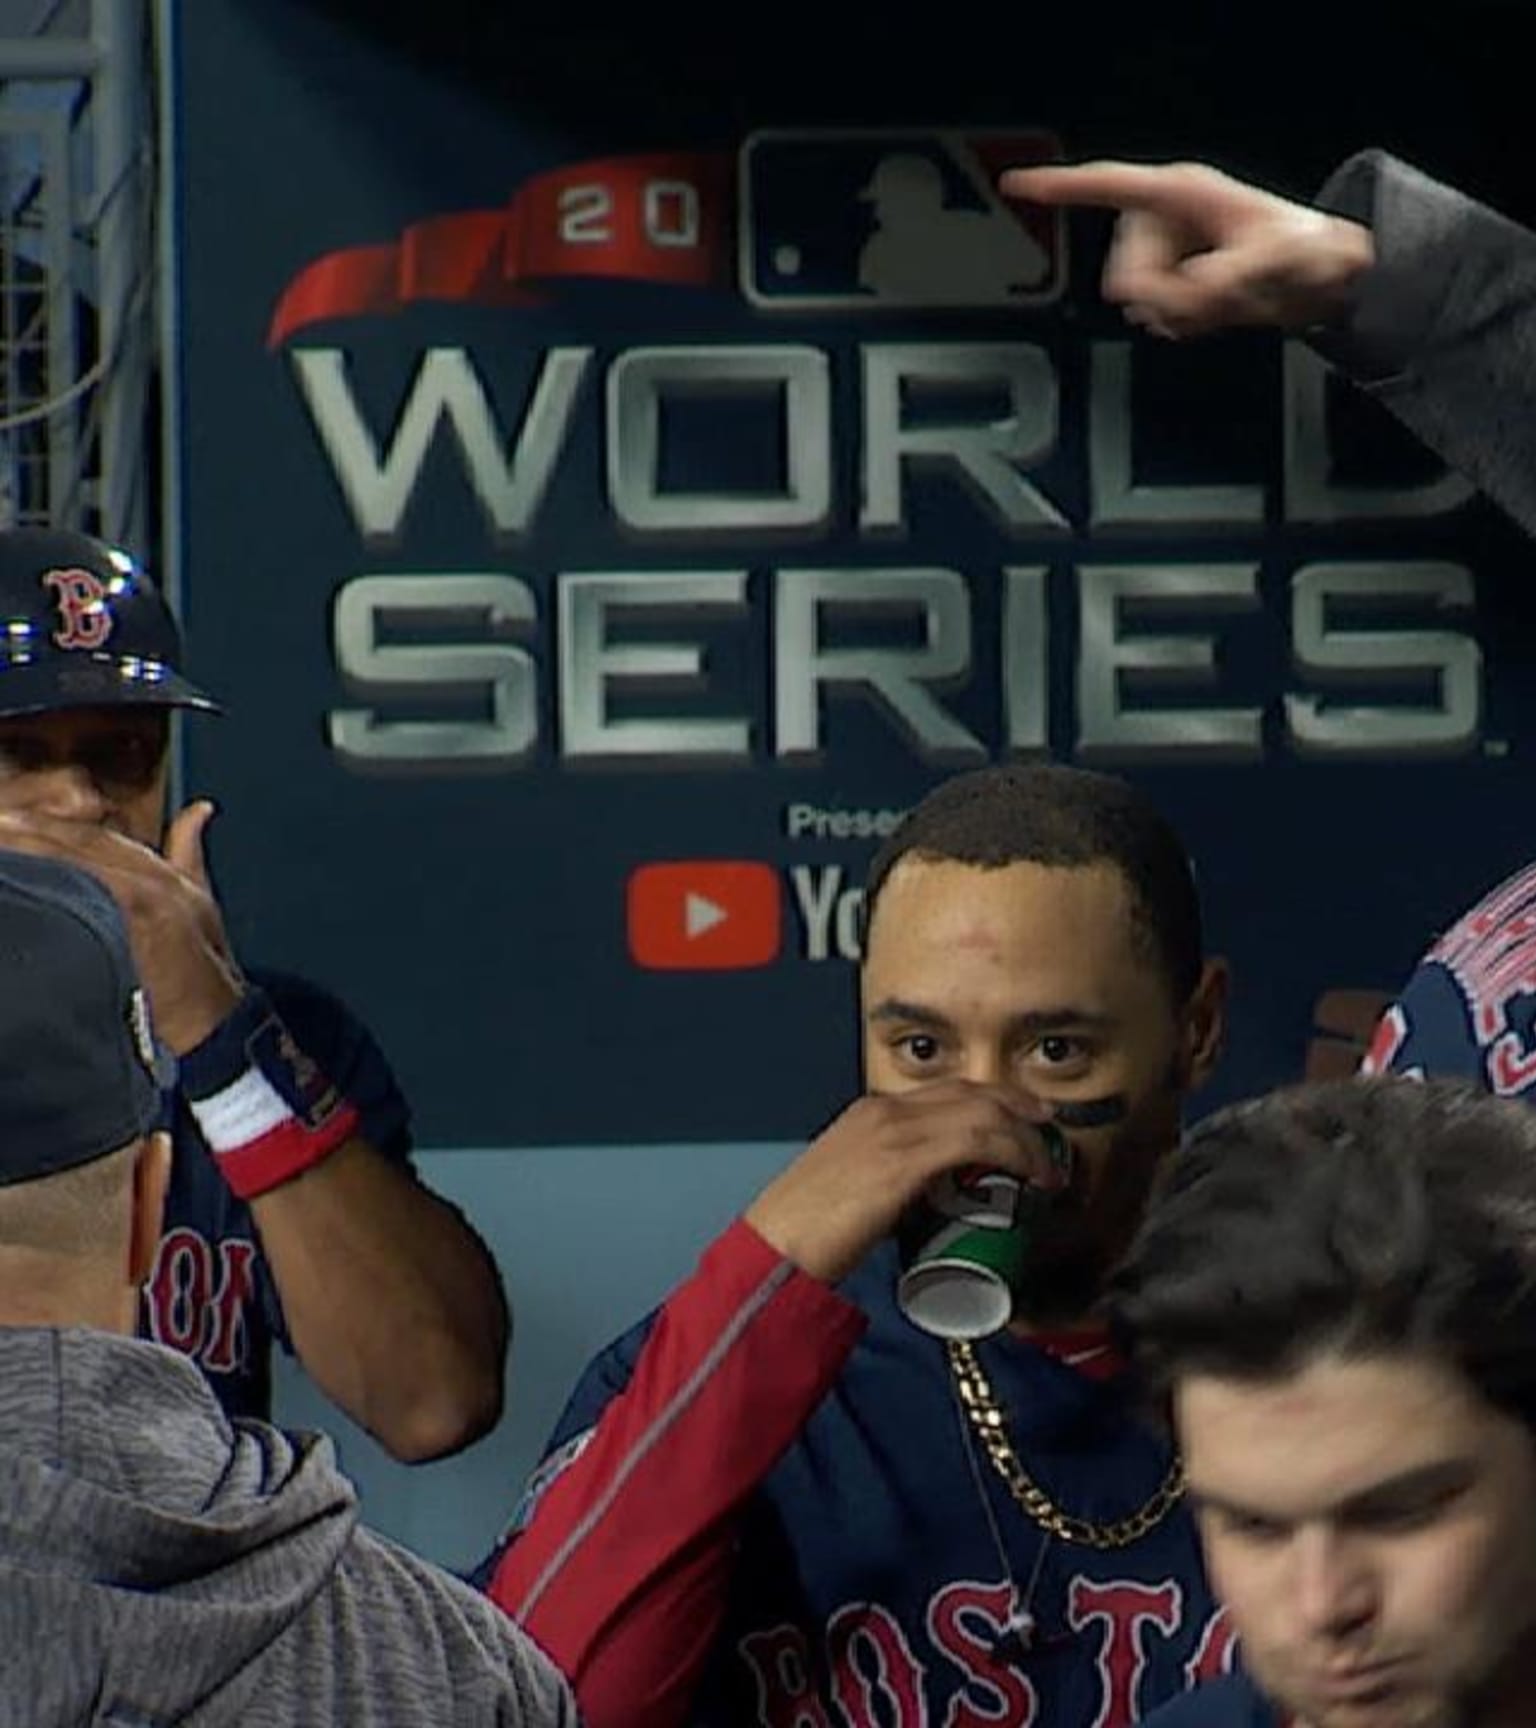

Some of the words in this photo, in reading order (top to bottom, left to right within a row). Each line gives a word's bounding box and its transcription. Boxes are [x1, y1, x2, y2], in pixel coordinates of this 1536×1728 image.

[292, 340, 1480, 537] WORLD
[330, 560, 1484, 762] SERIES
[787, 804, 905, 838] Prese
[790, 864, 864, 962] Yo
